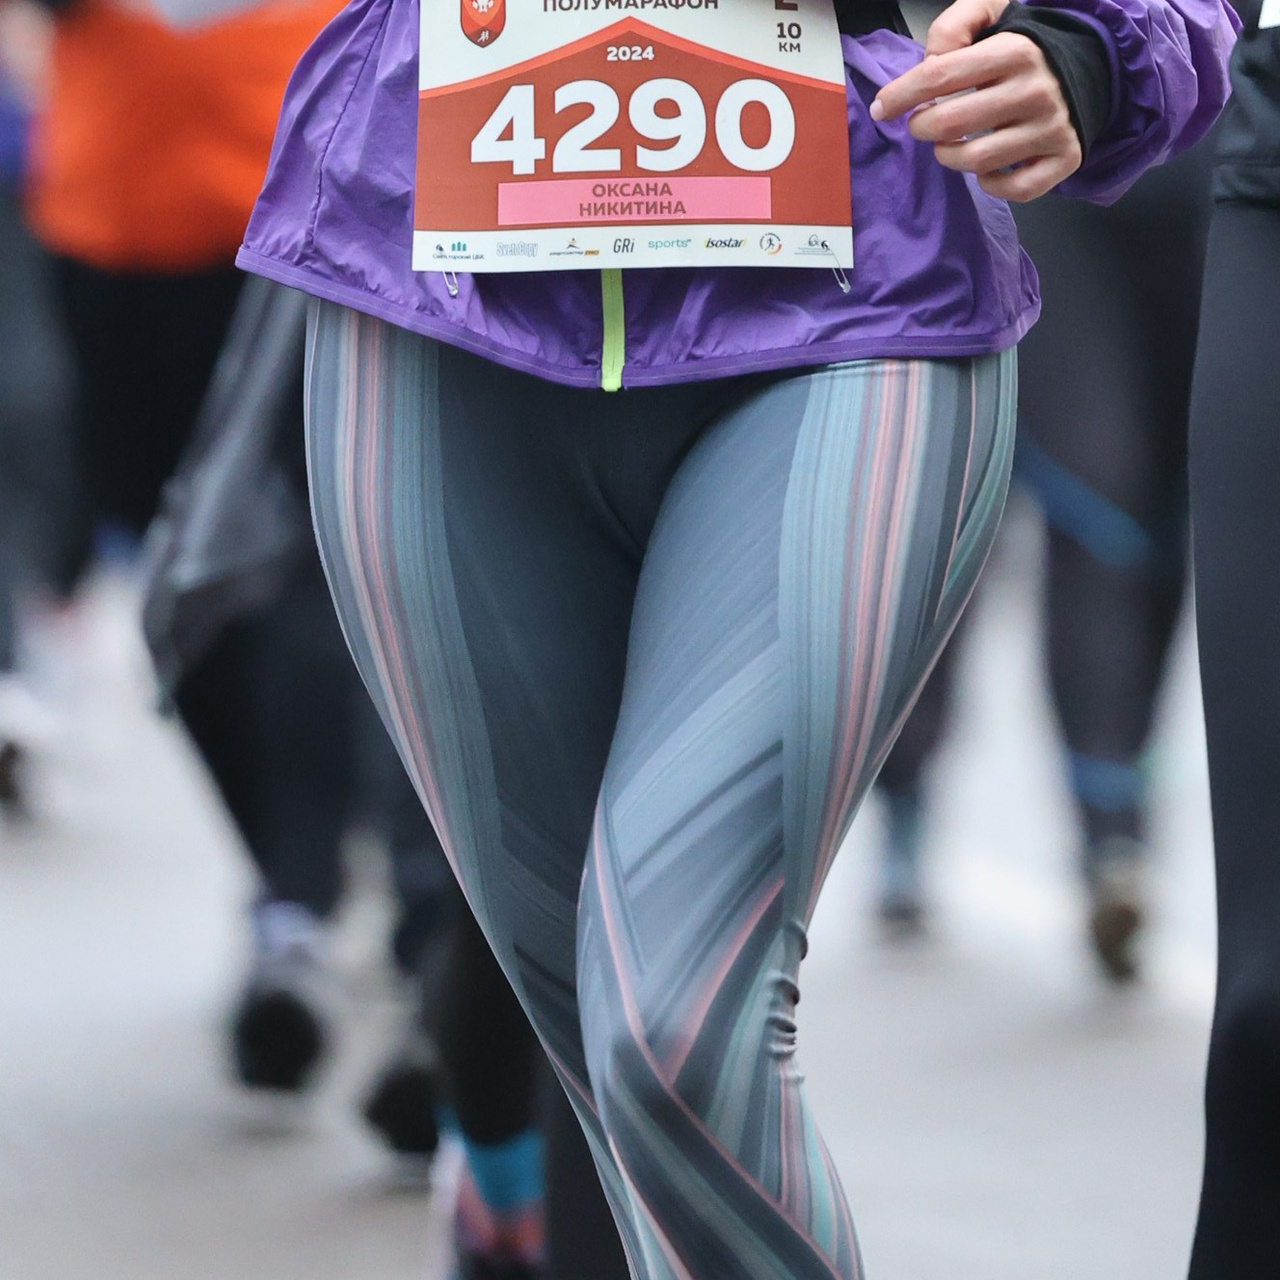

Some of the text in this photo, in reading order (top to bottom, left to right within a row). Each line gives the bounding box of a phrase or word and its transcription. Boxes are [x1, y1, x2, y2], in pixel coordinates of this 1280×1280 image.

[777, 22, 802, 39] 10
[606, 45, 655, 62] 2024
[778, 41, 802, 53] КМ
[470, 77, 796, 175] 4290
[591, 182, 673, 198] ОКСАНА
[579, 199, 687, 217] НИКИТИНА
[705, 237, 745, 249] isostar
